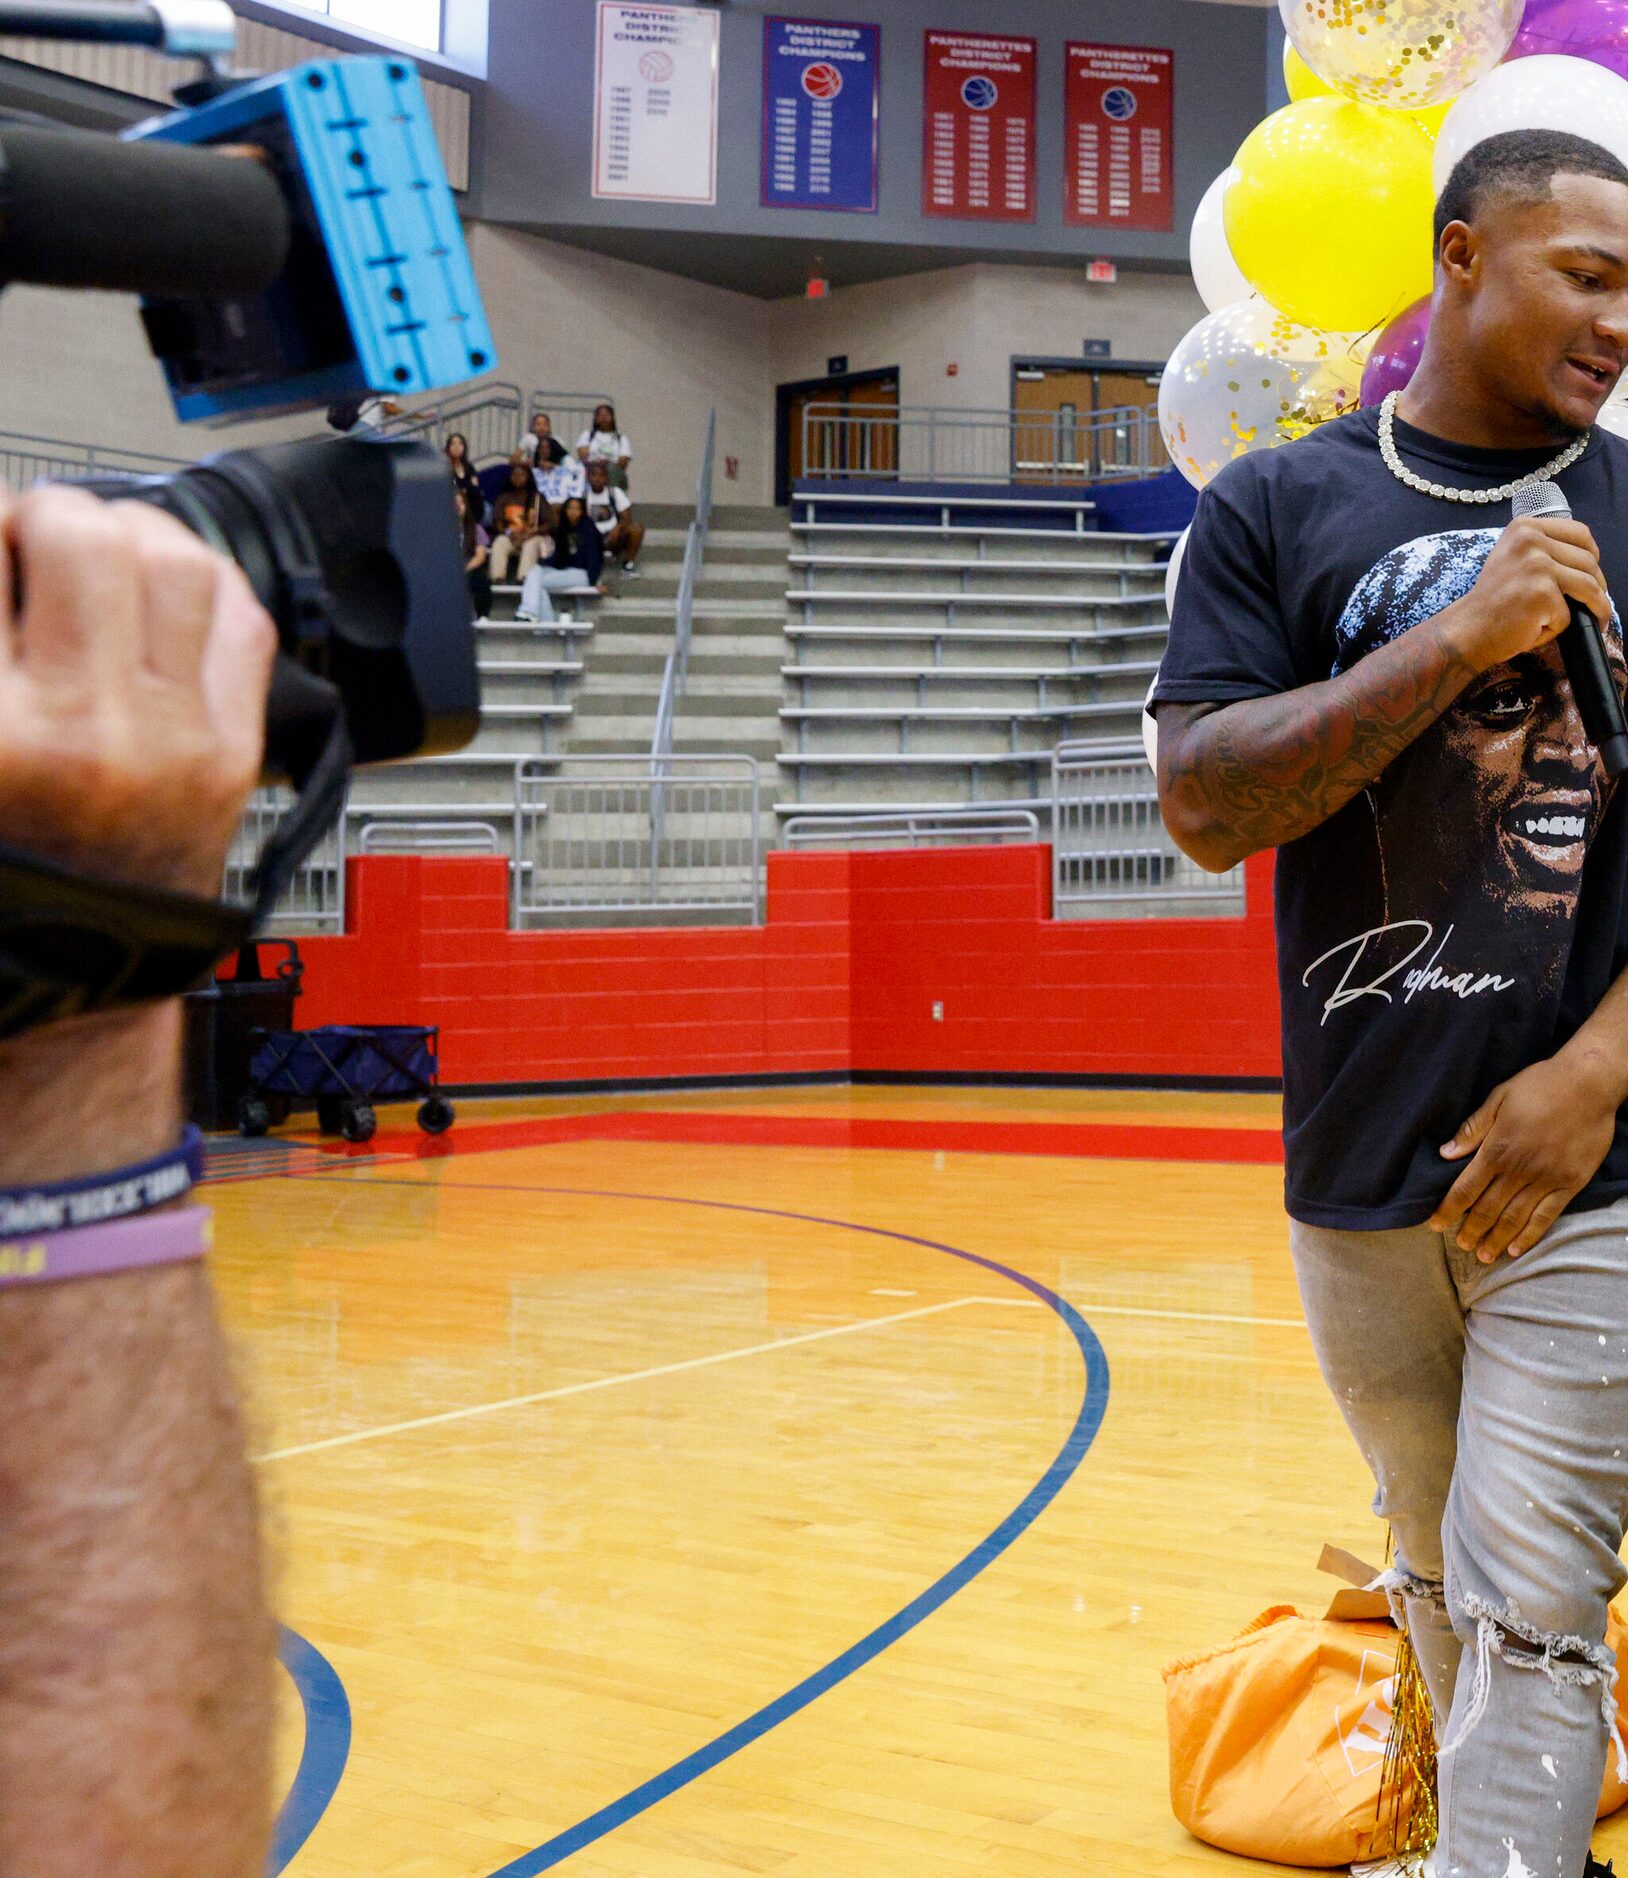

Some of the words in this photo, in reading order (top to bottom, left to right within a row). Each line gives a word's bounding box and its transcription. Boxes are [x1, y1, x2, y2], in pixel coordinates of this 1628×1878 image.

[784, 23, 861, 39] PANTHERS
[789, 35, 856, 49] DISTRICT
[929, 36, 1033, 53] PANTHERETTES
[778, 45, 866, 62] CHAMPIONS
[950, 48, 1012, 61] DISTRICT
[1069, 48, 1170, 64] PANTHERETTES
[938, 57, 1022, 73] CHAMPIONS
[1089, 59, 1150, 72] DISTRICT
[1079, 69, 1160, 84] CHAMPIONS
